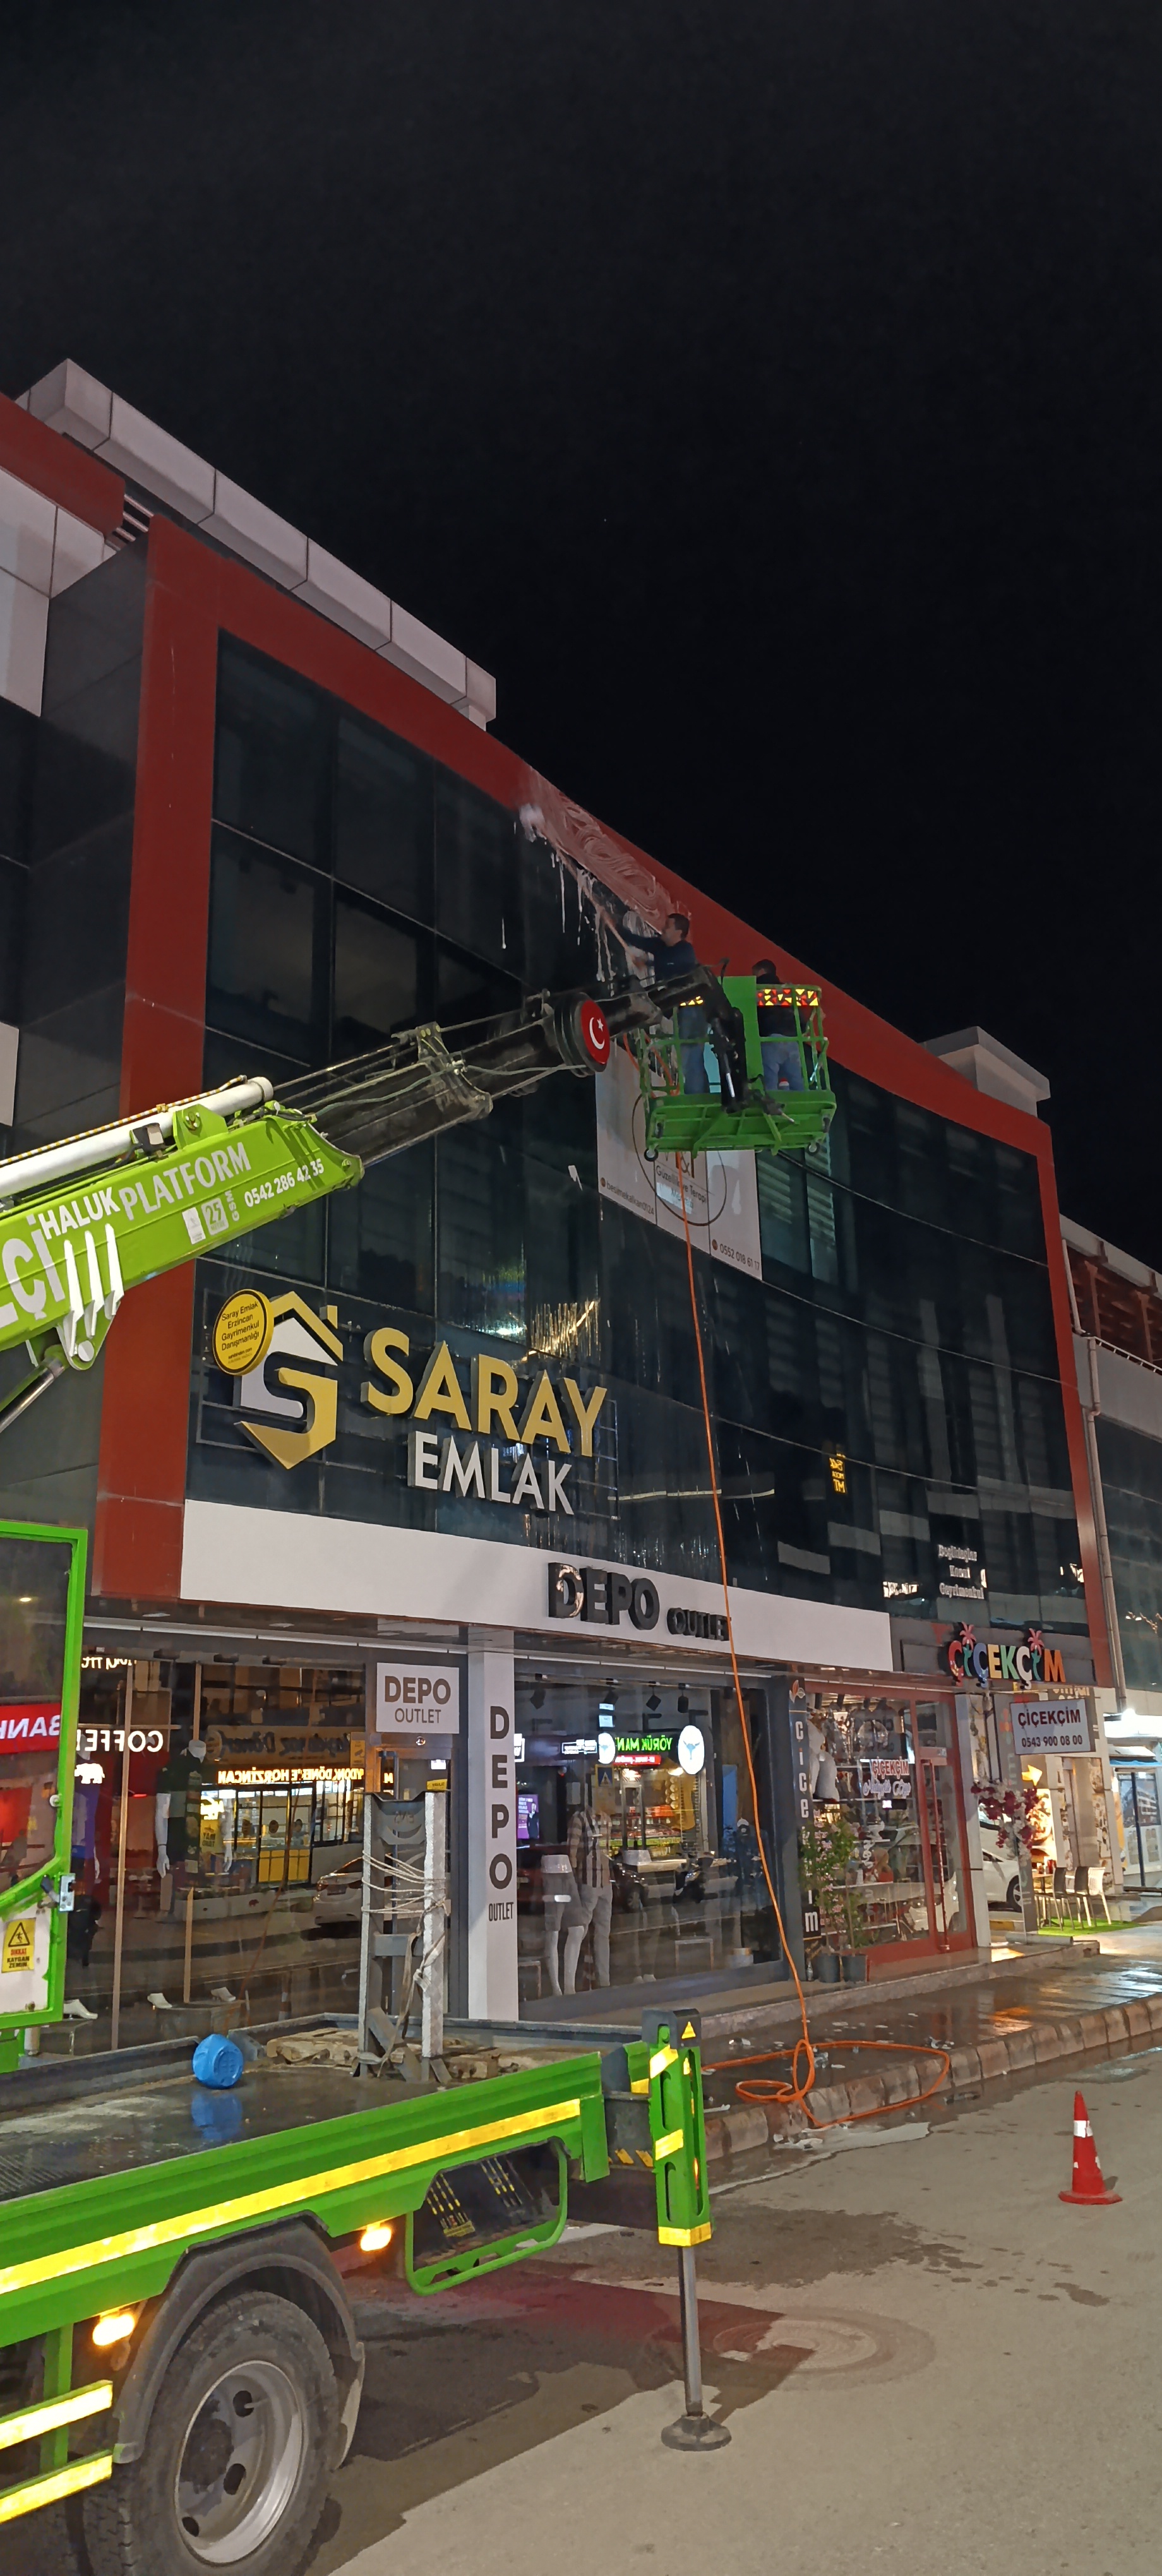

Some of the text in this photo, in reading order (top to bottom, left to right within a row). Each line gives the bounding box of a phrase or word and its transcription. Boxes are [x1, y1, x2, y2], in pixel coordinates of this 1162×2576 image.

[118, 1142, 251, 1221] PLATFORM
[244, 1159, 324, 1207] 0542 286 42 35
[39, 1187, 120, 1240] HALUK
[205, 1202, 222, 1225] 25
[225, 1189, 240, 1222] GSM
[720, 1243, 734, 1259] 0552
[736, 1251, 746, 1265] 018
[747, 1257, 753, 1268] 61
[222, 1301, 258, 1321] Saray Emlak
[228, 1314, 253, 1329] Erzincan
[222, 1320, 260, 1341] Gayrimenkul
[222, 1331, 260, 1351] Danışmanlığı
[361, 1327, 608, 1457] SARAY
[407, 1431, 575, 1515] EMLAK
[548, 1562, 660, 1630] DEPO
[949, 1621, 1066, 1690] ÇİÇEKÇİM
[385, 1676, 451, 1705] DEPO
[395, 1708, 441, 1723] OUTLET
[1017, 1707, 1081, 1729] ÇİÇEKÇİM
[1022, 1734, 1082, 1748] 0543 900 08 00
[489, 1706, 512, 1889] DEPO
[488, 1901, 514, 1923] OUTLET
